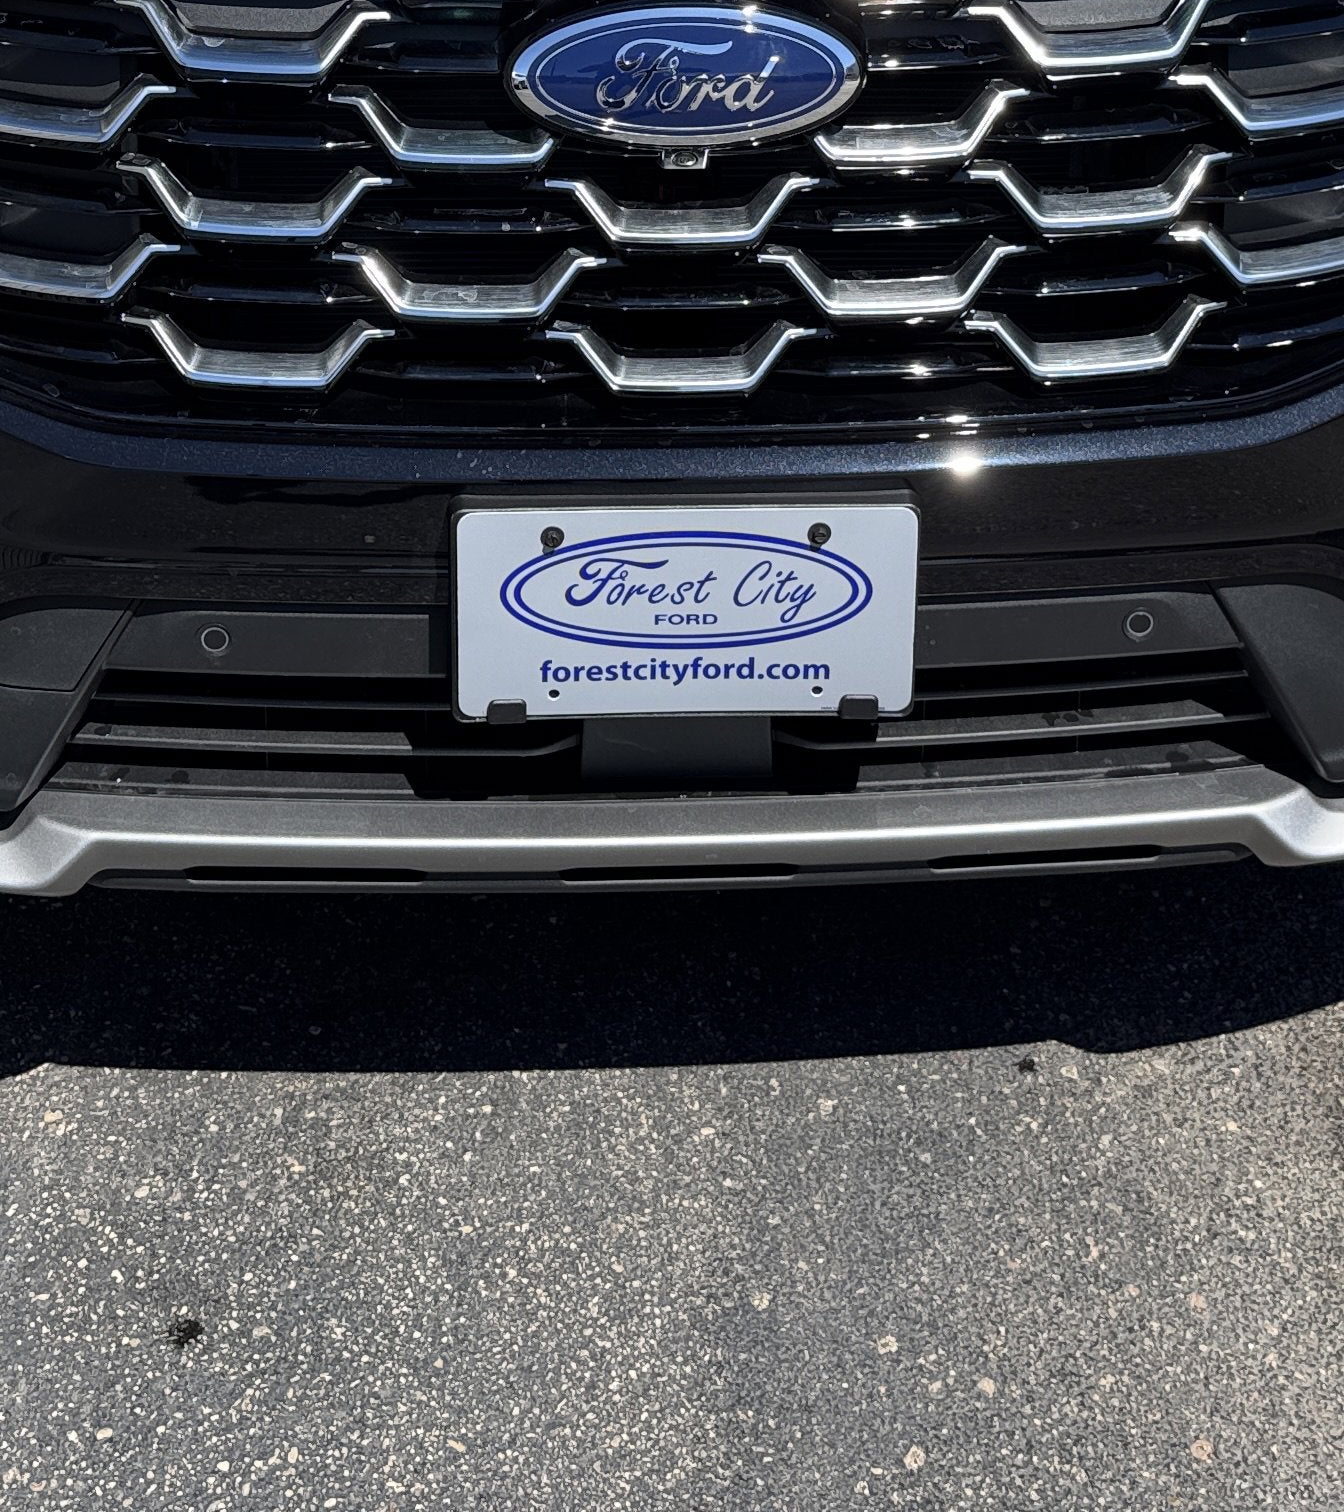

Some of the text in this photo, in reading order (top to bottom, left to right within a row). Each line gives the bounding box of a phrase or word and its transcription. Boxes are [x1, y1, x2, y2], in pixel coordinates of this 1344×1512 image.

[596, 38, 781, 113] Ford
[564, 558, 816, 623] Forest City
[653, 613, 718, 625] FORD
[540, 657, 831, 686] forestcityford.com
